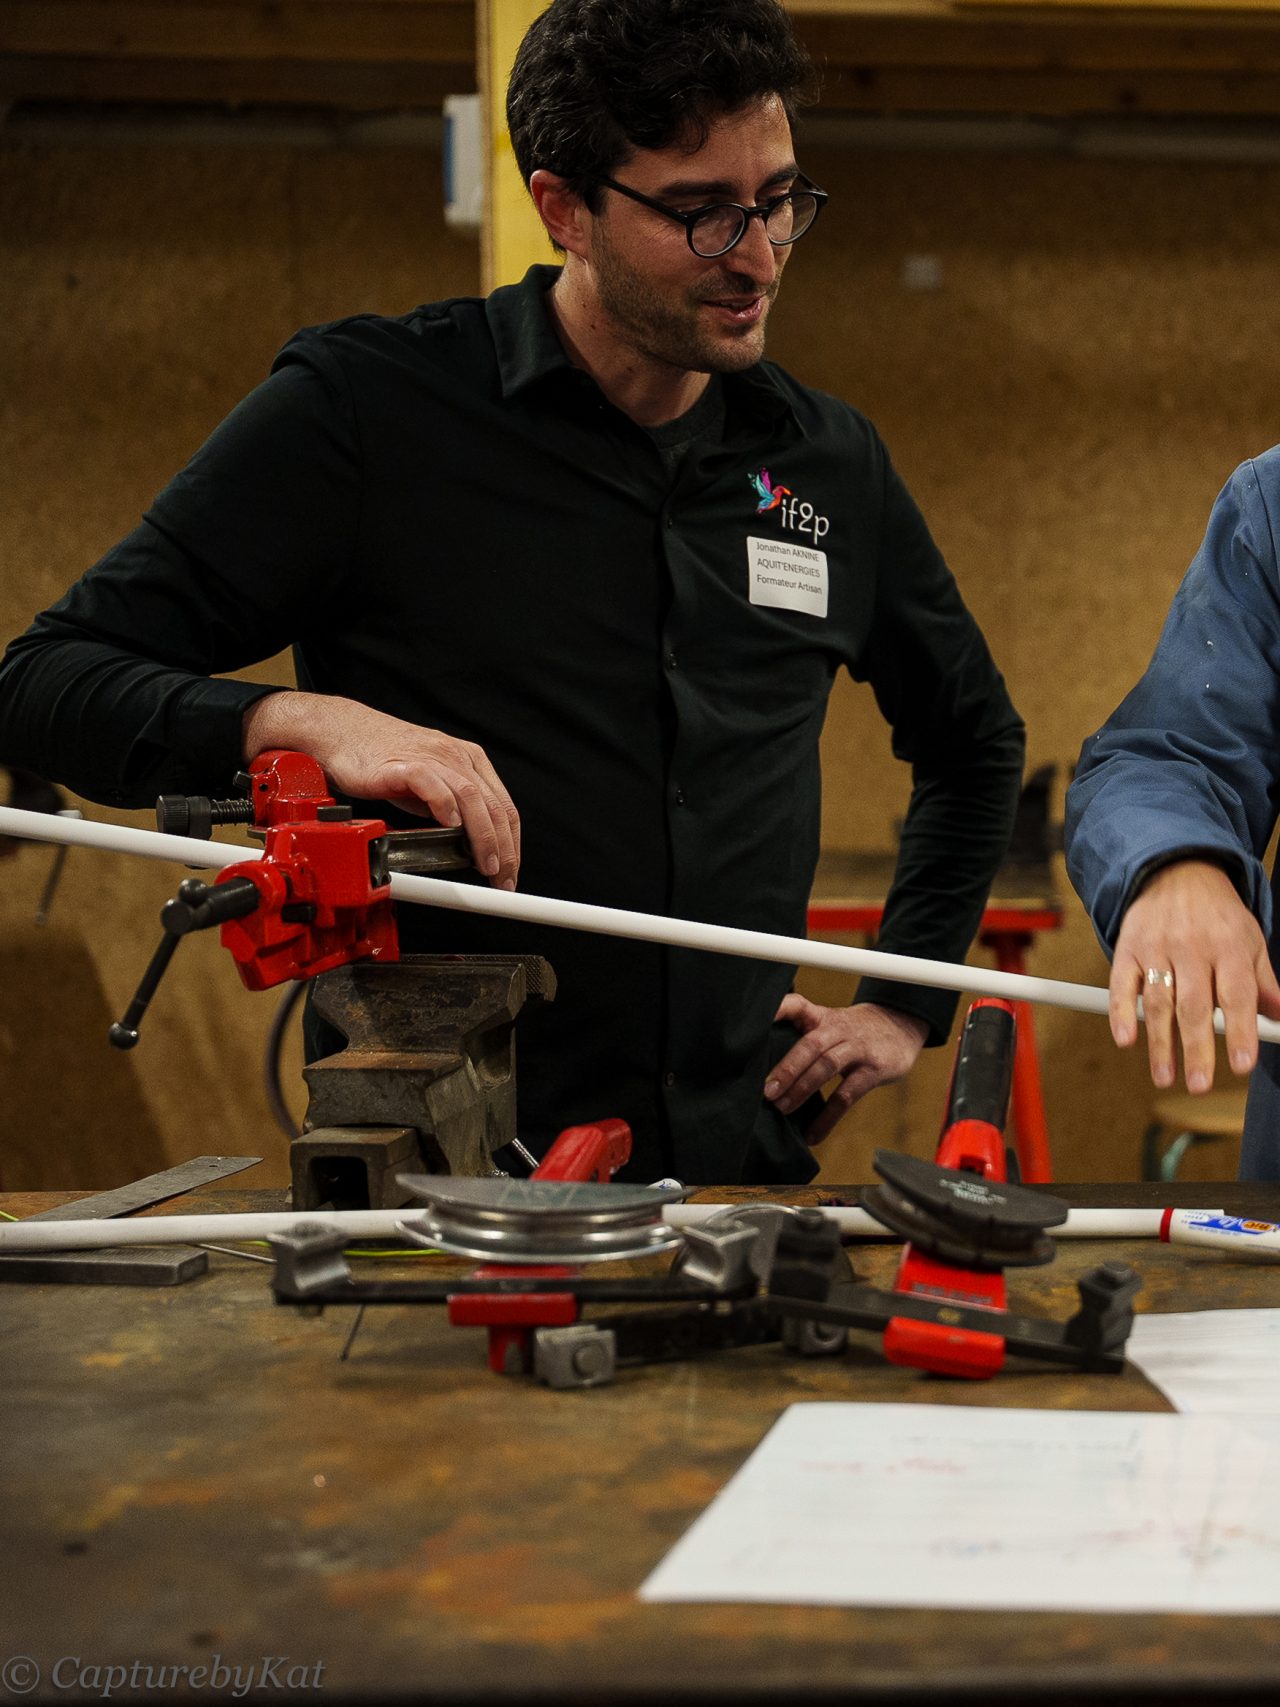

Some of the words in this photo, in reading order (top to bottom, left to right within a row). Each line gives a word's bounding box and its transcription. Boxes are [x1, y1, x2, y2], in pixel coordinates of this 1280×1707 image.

[782, 498, 829, 545] if2p
[756, 542, 791, 556] Jonathan
[757, 574, 797, 588] Formateur
[798, 582, 823, 594] Artisan
